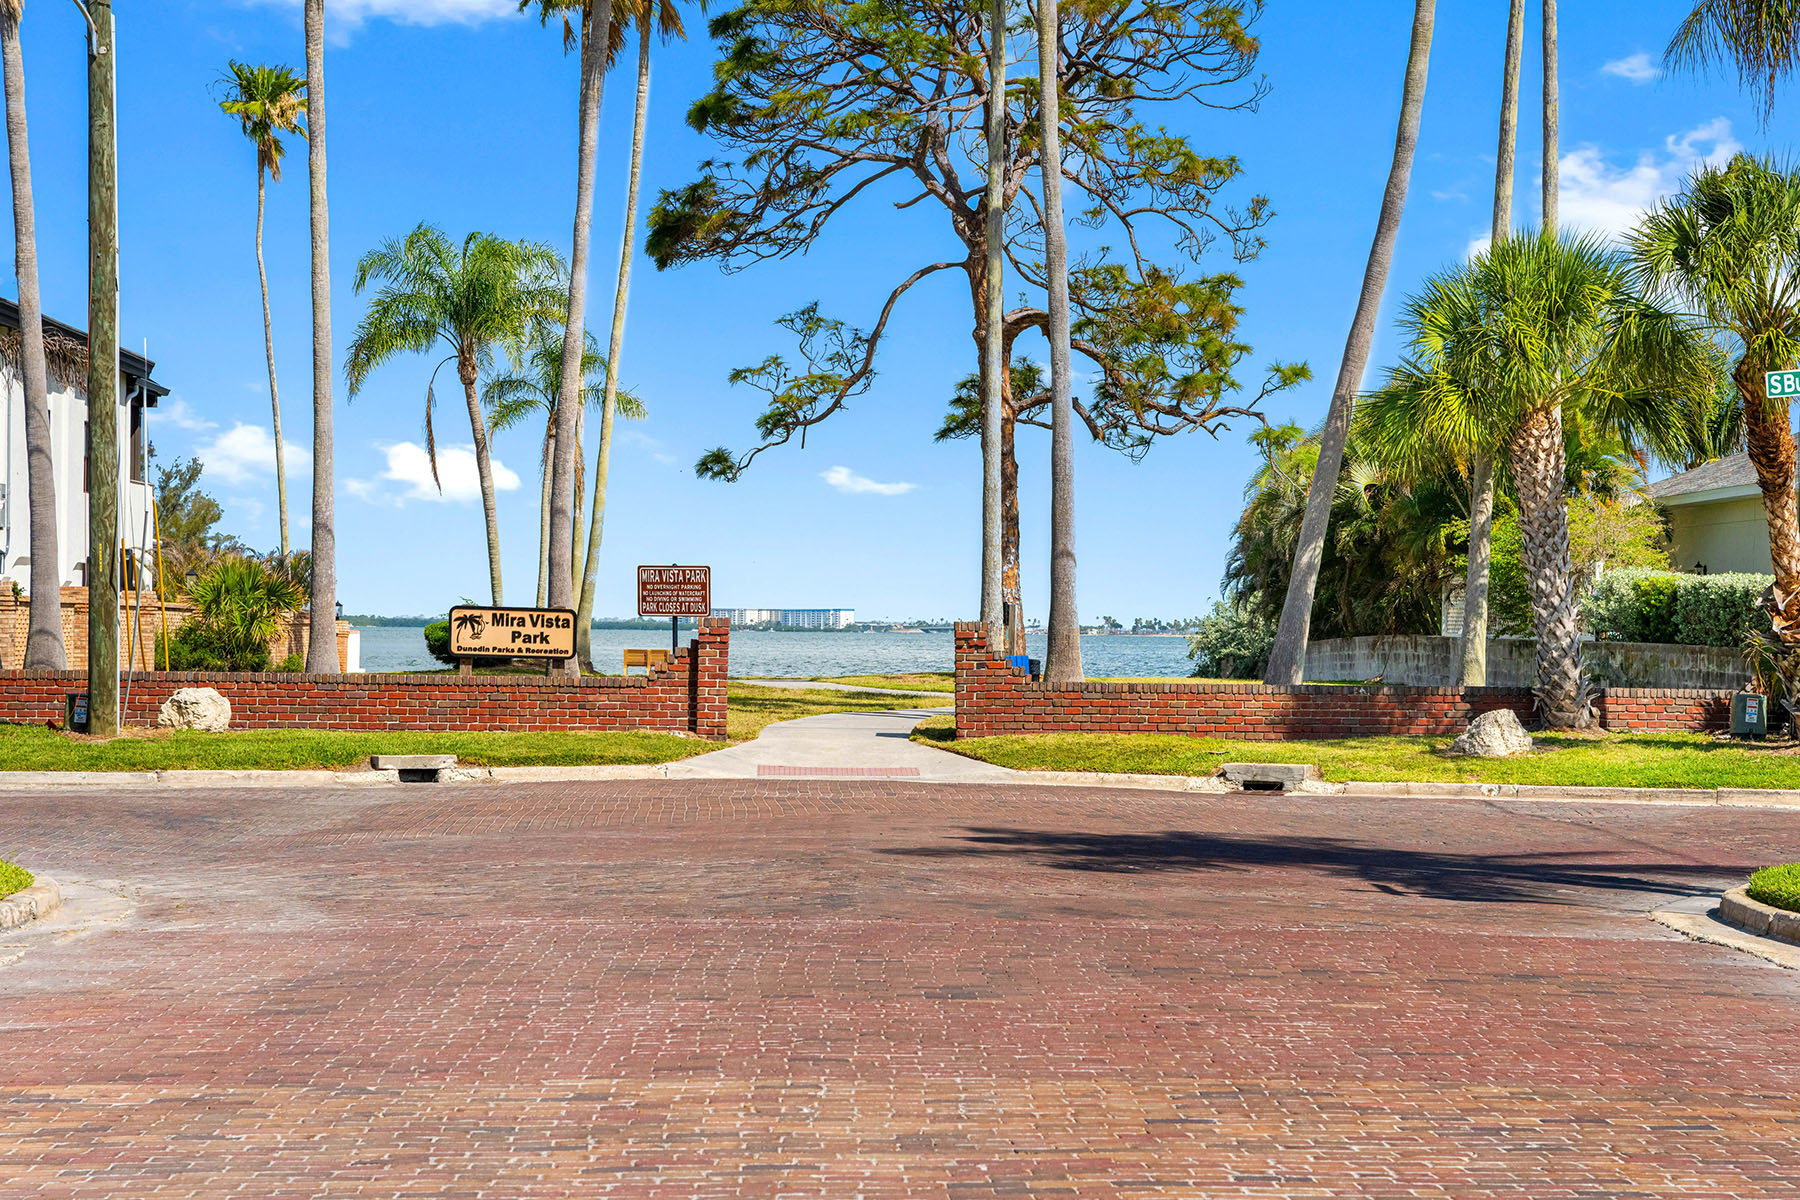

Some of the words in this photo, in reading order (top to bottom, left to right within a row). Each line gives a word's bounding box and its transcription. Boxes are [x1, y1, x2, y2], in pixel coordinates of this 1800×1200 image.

[642, 570, 660, 583] MIRA
[662, 570, 684, 583] VISTA
[686, 570, 706, 583] PARK
[643, 602, 658, 612] PARK
[659, 602, 680, 612] CLOSES
[682, 602, 689, 612] AT
[690, 602, 706, 612] DUSK
[492, 613, 526, 627] Mira
[529, 614, 570, 628] Vista
[511, 631, 550, 644] Park
